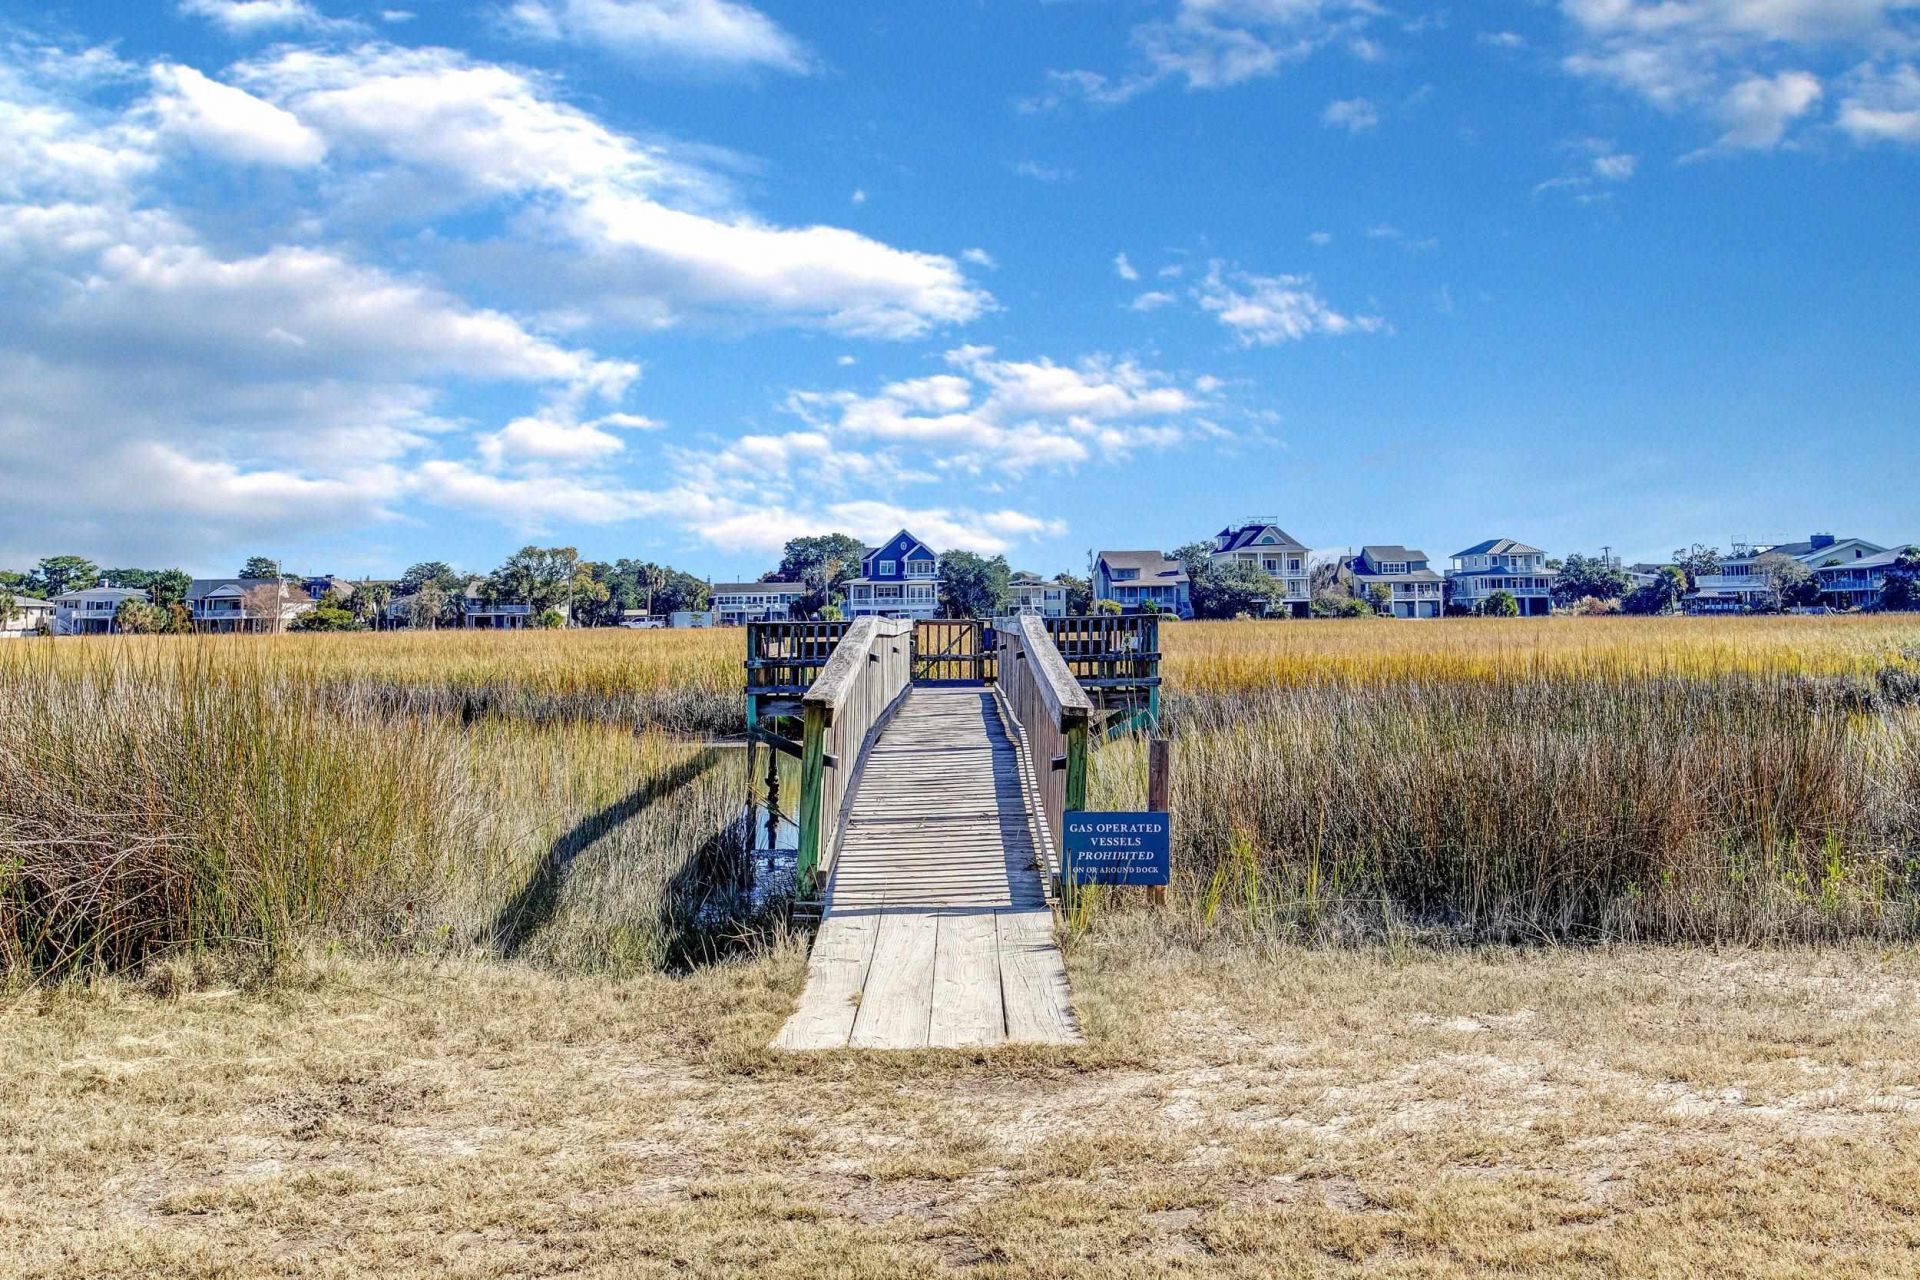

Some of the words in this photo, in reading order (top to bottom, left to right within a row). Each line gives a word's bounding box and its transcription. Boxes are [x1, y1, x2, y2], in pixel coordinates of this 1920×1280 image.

[1069, 823, 1093, 833] GAS
[1096, 823, 1162, 833] OPERATED
[1090, 837, 1142, 846] VESSELS
[1078, 851, 1154, 860] PROHIBITED
